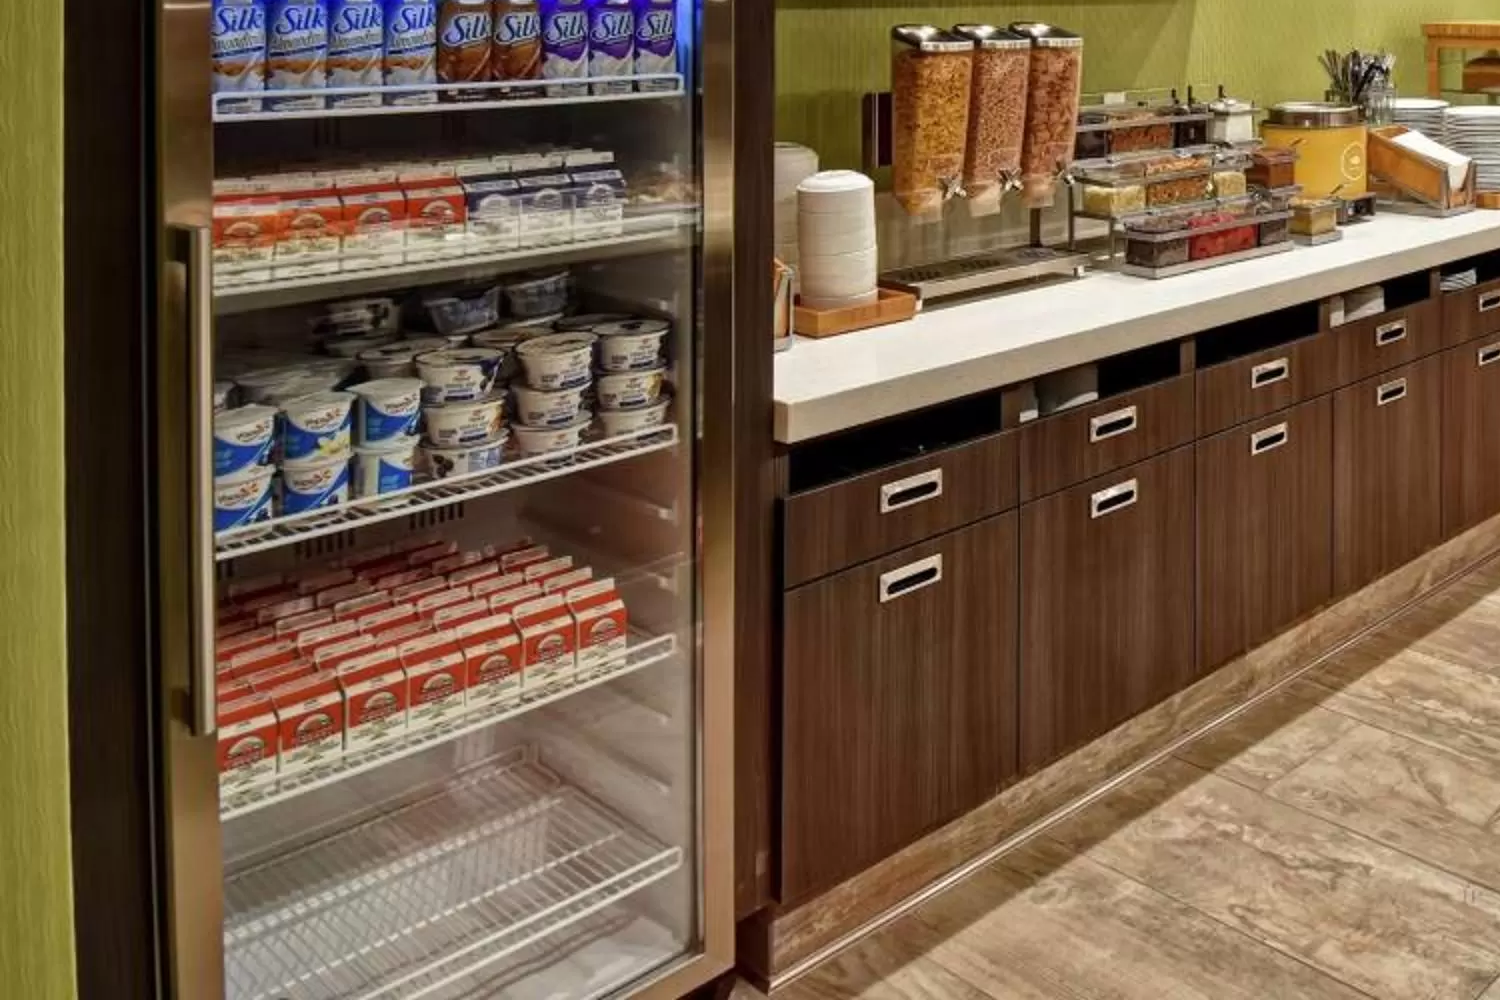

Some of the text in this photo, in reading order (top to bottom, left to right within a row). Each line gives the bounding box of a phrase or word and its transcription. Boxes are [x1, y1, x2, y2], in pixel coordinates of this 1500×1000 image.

[212, 7, 263, 36] Silk
[275, 6, 324, 35] Silk
[334, 6, 380, 34] Silk
